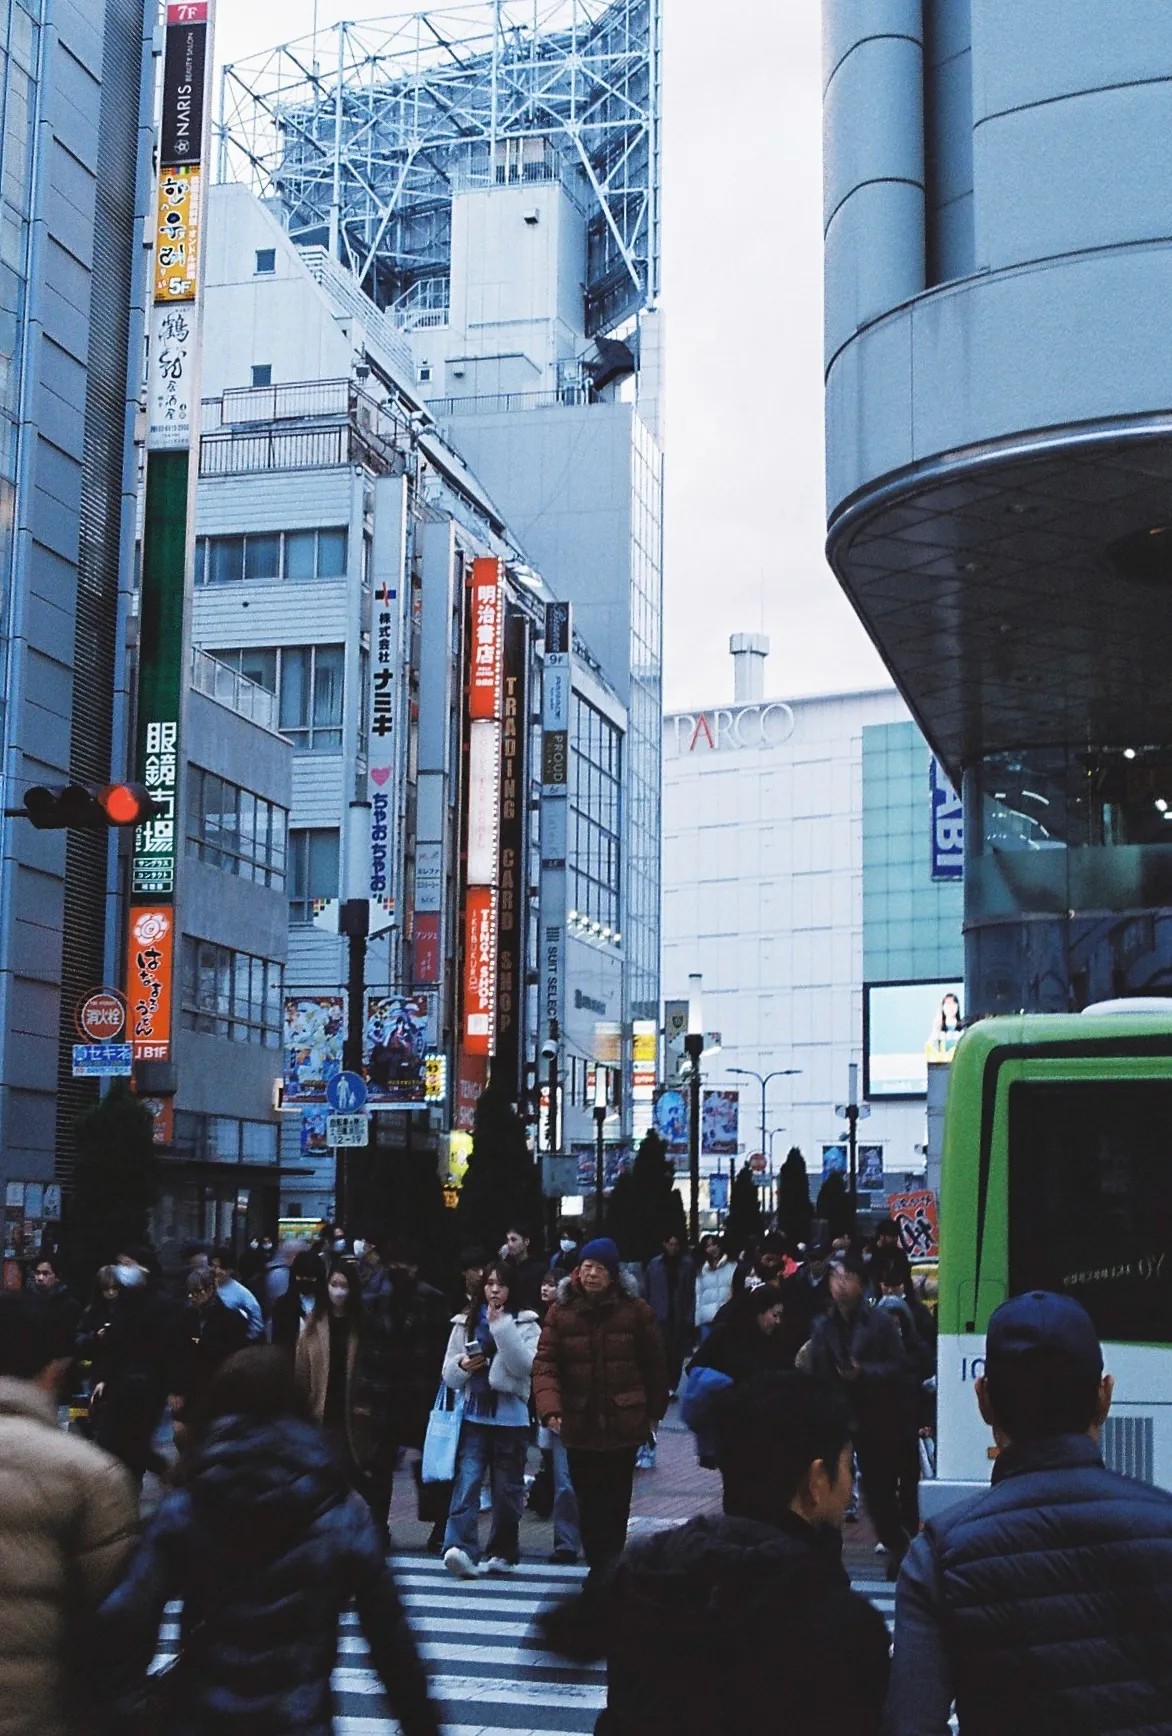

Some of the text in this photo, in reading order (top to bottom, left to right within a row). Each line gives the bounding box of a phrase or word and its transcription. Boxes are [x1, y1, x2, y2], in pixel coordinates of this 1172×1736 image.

[177, 4, 197, 20] 7F
[177, 32, 194, 137] NARIS BEAUTY SALON
[168, 277, 191, 294] 5F
[372, 612, 393, 737] 株式会社 ナミキ
[673, 703, 794, 752] PARCO
[143, 722, 177, 852] 眼鏡市場
[553, 734, 563, 783] PROUD
[500, 677, 517, 1033] TRADING CARD SHOP
[469, 909, 478, 985] IKEBUKURO
[478, 909, 490, 1009] TENGA SHOP
[548, 946, 558, 974] SUIT
[136, 946, 162, 1012] はなまる
[86, 1008, 121, 1025] 消火栓
[135, 1000, 154, 1037] うどん
